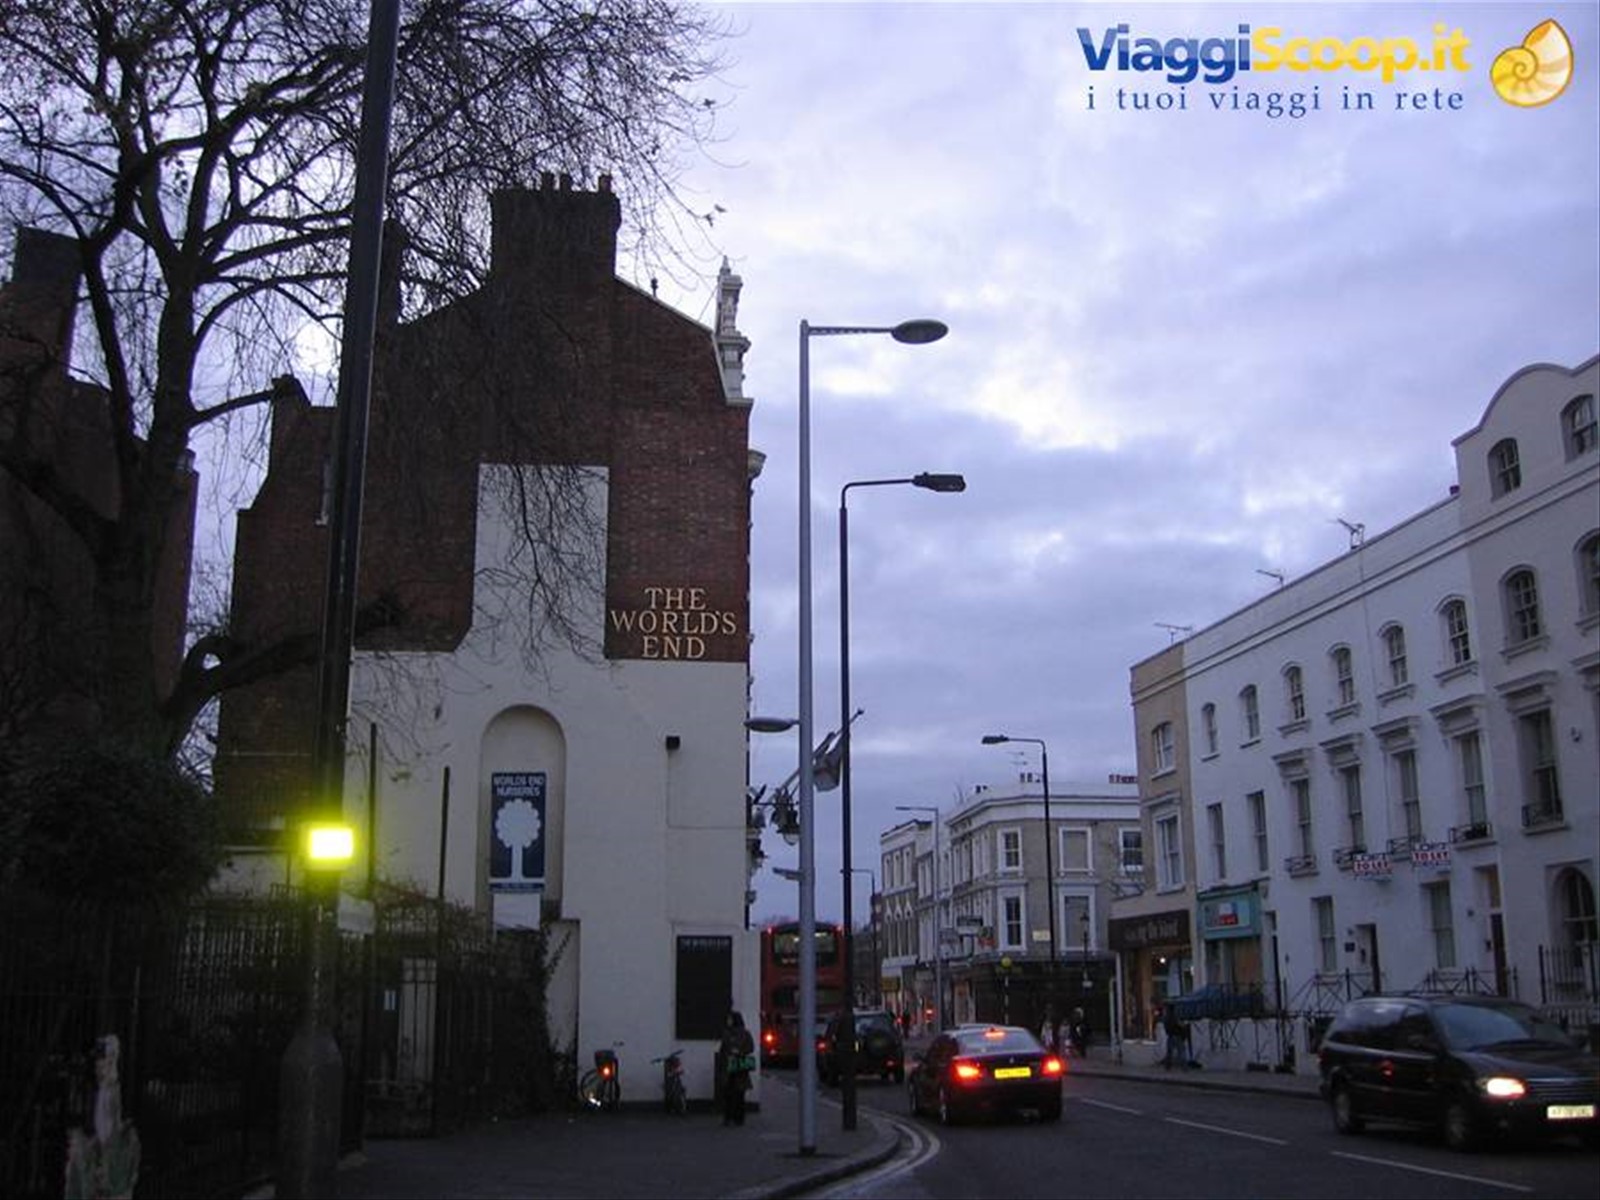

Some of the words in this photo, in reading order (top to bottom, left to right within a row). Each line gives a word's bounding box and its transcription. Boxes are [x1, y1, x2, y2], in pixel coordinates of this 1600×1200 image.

[644, 586, 707, 610] THE
[610, 609, 737, 635] WORLD'S
[641, 635, 706, 659] END
